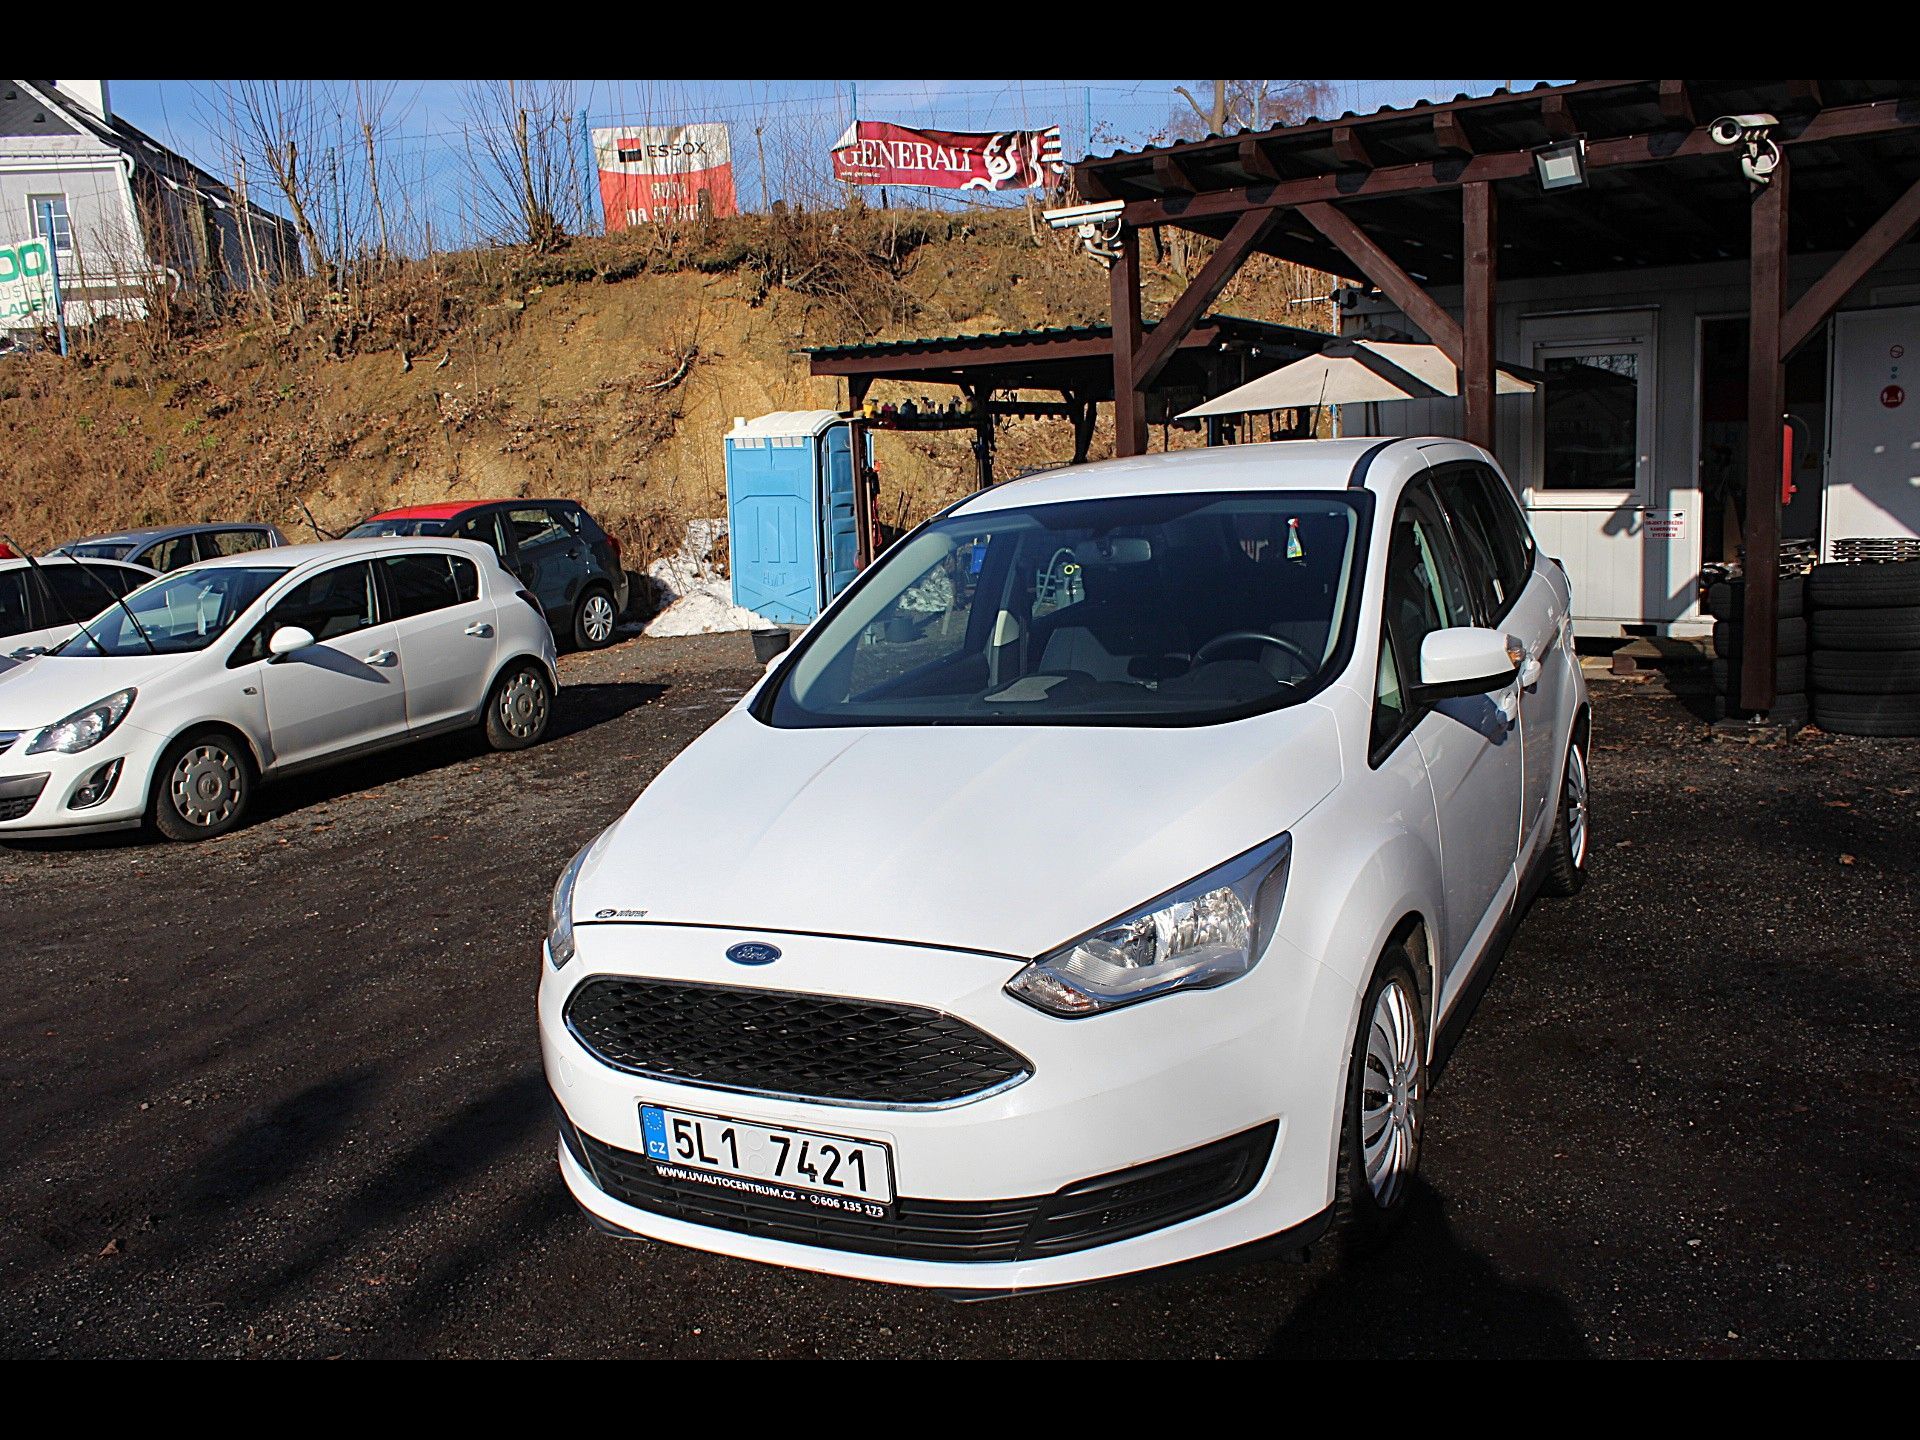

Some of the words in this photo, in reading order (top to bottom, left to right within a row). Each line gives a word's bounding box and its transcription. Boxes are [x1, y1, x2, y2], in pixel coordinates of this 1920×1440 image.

[647, 141, 707, 158] ESSOX
[838, 138, 973, 172] GENERALI
[649, 1140, 667, 1155] CZ
[672, 1117, 740, 1169] 5L1
[769, 1134, 868, 1193] 7421
[655, 1165, 797, 1201] WWW.UVAUTOCENTRUM.CZ
[819, 1197, 841, 1211] 606
[842, 1201, 862, 1214] 135
[864, 1204, 885, 1217] 173
